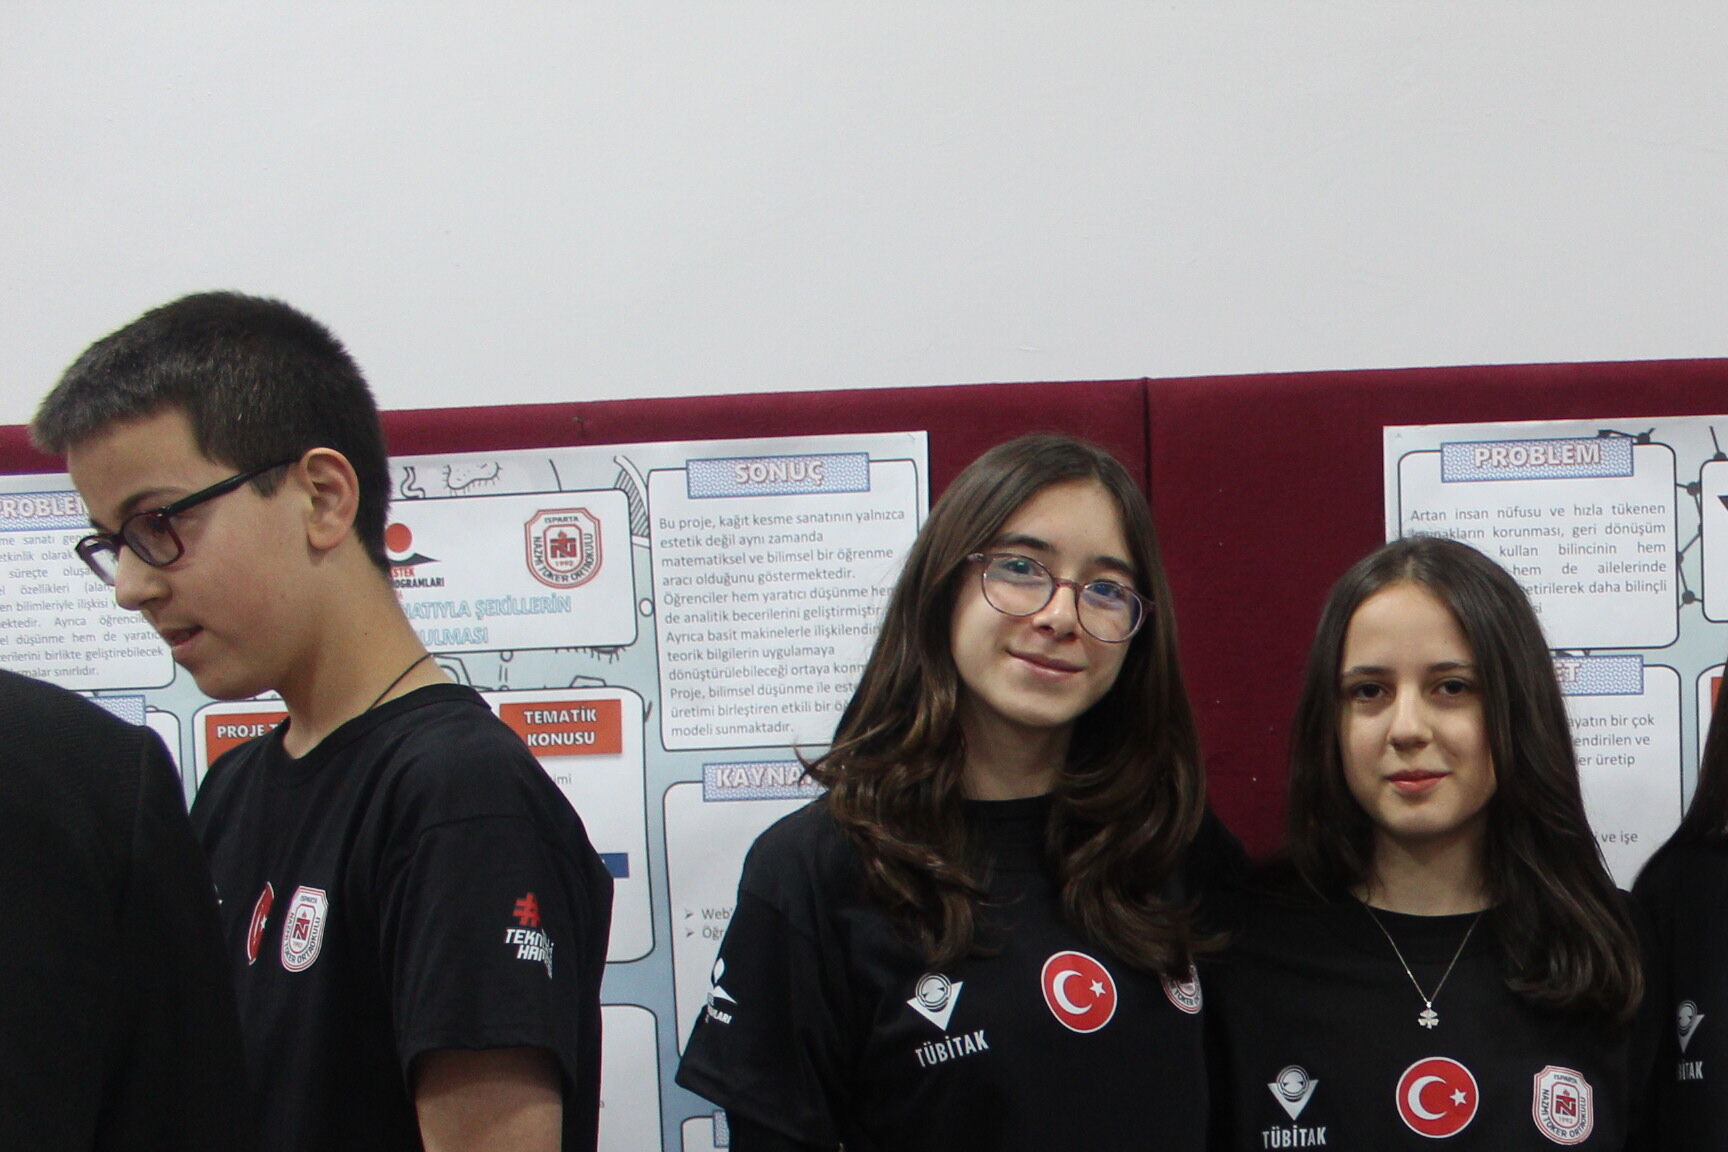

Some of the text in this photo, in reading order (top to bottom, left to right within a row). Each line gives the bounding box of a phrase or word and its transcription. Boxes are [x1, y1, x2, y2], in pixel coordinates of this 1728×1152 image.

[1474, 443, 1602, 469] PROBLEM
[734, 461, 824, 486] SONUÇ
[544, 515, 580, 524] ISPARTA
[659, 517, 676, 529] Bu
[719, 514, 749, 530] kağıt
[752, 513, 793, 526] kesme
[796, 512, 853, 523] sanatının
[856, 508, 905, 523] yalnızca
[1410, 502, 1666, 522] Artan insan nüfusu ve hızla tükenen
[1572, 523, 1597, 539] geri
[1604, 522, 1666, 536] dönüşüm
[660, 530, 823, 550] estetik değil aynı zamanda
[1499, 541, 1666, 557] kullan bilincinin hem
[749, 554, 764, 564] ve
[767, 550, 814, 563] bilimsel
[817, 549, 833, 561] bir
[837, 547, 893, 562] öğrenme
[662, 576, 693, 586] aracı
[696, 571, 755, 587] olduğunu
[474, 591, 572, 620] ŞEKİLLERİN
[421, 627, 489, 645] ULMASI
[523, 707, 598, 725] TEMATİK
[1610, 714, 1655, 729] bir çok
[216, 723, 267, 740] PROJE
[526, 731, 596, 747] KONUSU
[671, 723, 713, 737] modeli
[914, 1029, 990, 1068] TÜBİTAK
[1262, 1124, 1327, 1150] TÜBİTAK
